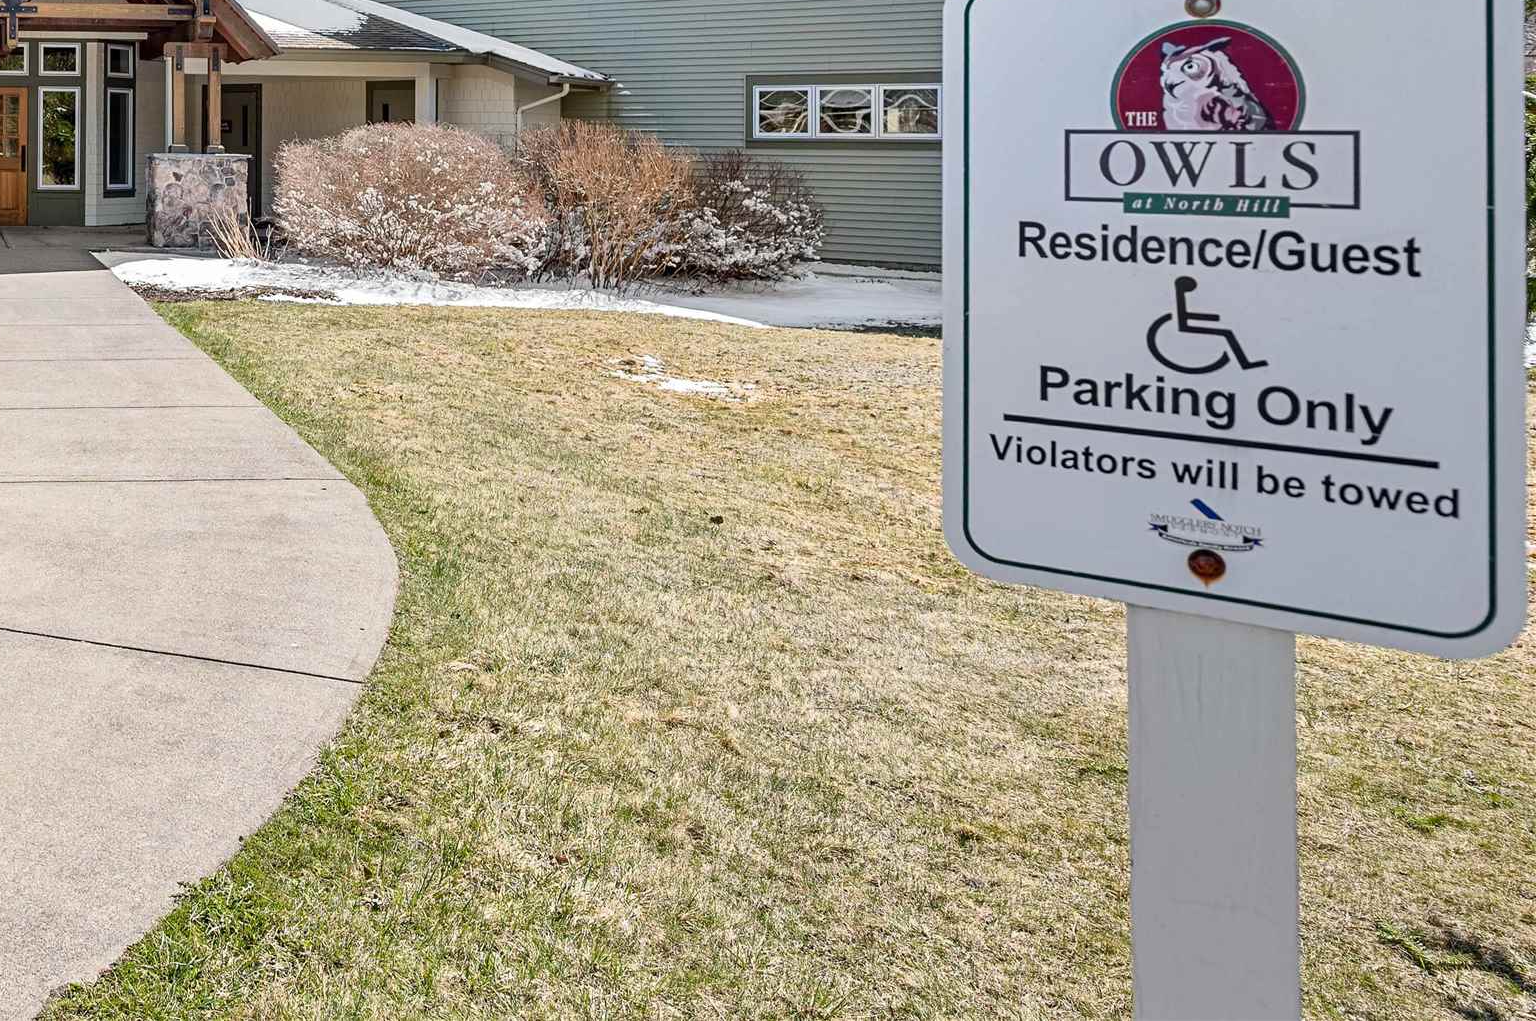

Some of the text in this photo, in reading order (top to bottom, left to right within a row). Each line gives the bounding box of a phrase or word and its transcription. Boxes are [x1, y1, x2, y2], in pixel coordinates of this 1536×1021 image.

[1125, 111, 1158, 126] THE
[1099, 140, 1320, 190] OWLS
[1131, 197, 1282, 213] at North Hill
[1017, 221, 1422, 278] Residence/Guest
[1038, 364, 1393, 445] Parking Only
[989, 433, 1460, 519] Violators will be towed
[1220, 522, 1261, 537] NOTCH
